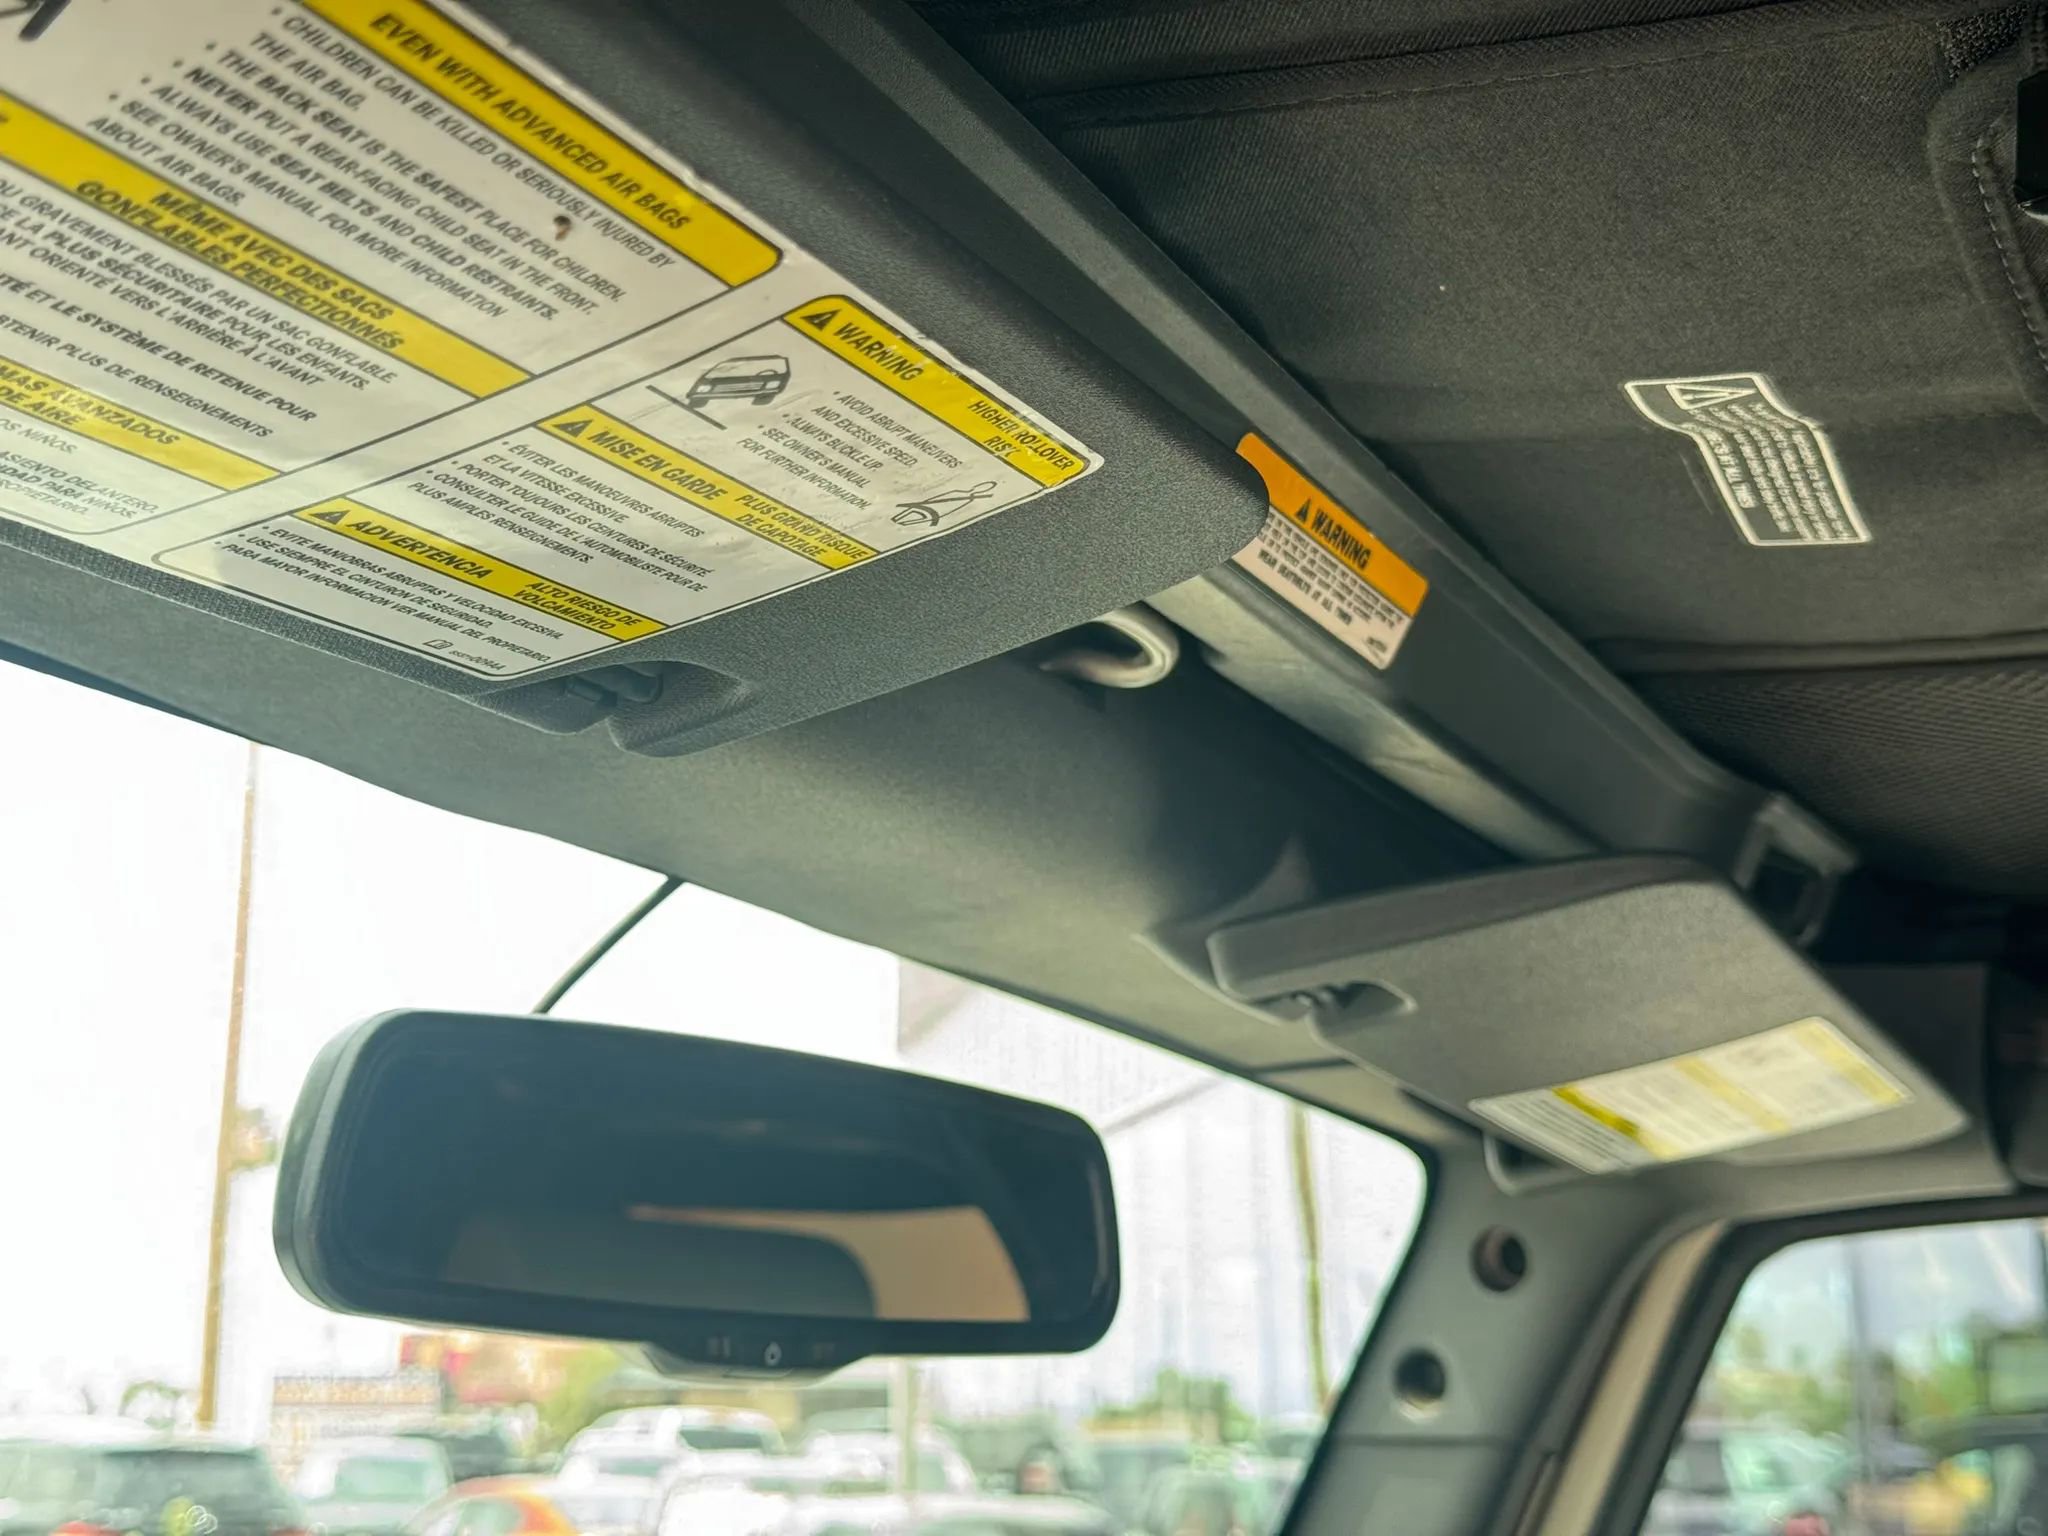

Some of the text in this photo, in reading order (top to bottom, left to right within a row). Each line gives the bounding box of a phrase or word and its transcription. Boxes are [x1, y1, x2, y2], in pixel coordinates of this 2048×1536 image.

[251, 32, 365, 107] THE AIR BAG.
[283, 17, 675, 267] CHILDREN CAN BE KILLED OR SERIOUSLY INJURED BY
[370, 13, 690, 228] EVEN WITH ADVANCED AIR BAGS
[89, 118, 245, 203] ABOUT AIR BAGS.
[185, 68, 598, 314] NEVER PUT REAR-FACING CHILD SEAT IN THE FRONT.
[219, 50, 626, 302] THE BACK SEAT IS THE SAFEST PLACE FOR CHILDREN.
[76, 181, 237, 264] GONFLABLES
[121, 101, 507, 317] SEE OWNER'S MANUAL FOR MORE INFORMATION
[152, 86, 558, 320] ALWAYS USE SEAT BELTS AND CHILD RESTRAINTS.
[14, 217, 45, 234] LA
[43, 230, 102, 260] PLUS
[219, 316, 271, 342] POUR
[265, 338, 301, 356] LES
[19, 196, 138, 253] GRAVEMENT
[209, 289, 250, 310] PAR
[245, 307, 277, 323] UN
[271, 320, 310, 339] SAC
[110, 284, 160, 310] VERS
[224, 234, 293, 267] AVEC
[287, 264, 338, 290] DES
[331, 288, 393, 319] SACS
[25, 289, 55, 303] ET
[162, 351, 194, 366] DE
[189, 363, 272, 400] RETENUE
[265, 397, 317, 421] POUR
[833, 322, 924, 380] WARNING
[23, 401, 80, 425] AIRE
[56, 343, 273, 437] PLUS RENSEIGNEMENTS
[737, 438, 766, 452] FOR
[758, 449, 810, 476] FURTHER
[762, 428, 790, 442] SEE
[826, 463, 871, 488] MANUAL
[786, 417, 868, 461] ALWAYS BUCKLE
[811, 406, 841, 421] AND
[834, 418, 891, 450] EXCESSIVE
[836, 395, 963, 468] AVOID ABRUPT MANEUVERS
[967, 400, 1075, 469] HIGHER ROLLOVER
[408, 482, 447, 499] PLUS
[441, 497, 496, 520] AMPLES
[518, 469, 571, 495] VITESSE
[549, 464, 579, 478] LES
[572, 475, 653, 513] MANOEUVRES
[647, 511, 705, 537] ABRUPTES
[587, 430, 728, 500] MISE EN GARDE
[433, 473, 510, 507] CONSULTER
[520, 511, 562, 529] GUIDE
[659, 571, 693, 585] POUR
[457, 464, 511, 488] PORTER
[506, 484, 571, 514] TOUJOURS
[587, 522, 650, 550] CEINTURES
[734, 494, 868, 559] PLUS GRAND RISQUE
[735, 513, 828, 557] DE CAPOTAGE
[1311, 509, 1371, 569] WARNING
[246, 536, 280, 549] USE
[274, 547, 336, 570] SIEMPRE
[348, 574, 414, 598] CINTURON
[269, 529, 314, 545] EVITE
[307, 543, 387, 573] MANIOBRAS
[381, 571, 447, 595] ABRUPTAS
[452, 596, 516, 621] VELOCIDAD
[346, 522, 492, 578] ADVERTENCIA
[222, 544, 261, 559] PARA
[258, 556, 309, 575] MAYOR
[304, 573, 395, 606] INFORMACION
[390, 603, 418, 614] VER
[412, 612, 459, 630] MANUAL
[460, 628, 483, 638] DEL
[513, 590, 616, 629] VOLCAMIENTO
[525, 582, 641, 625] ALTO RIESGO DE
